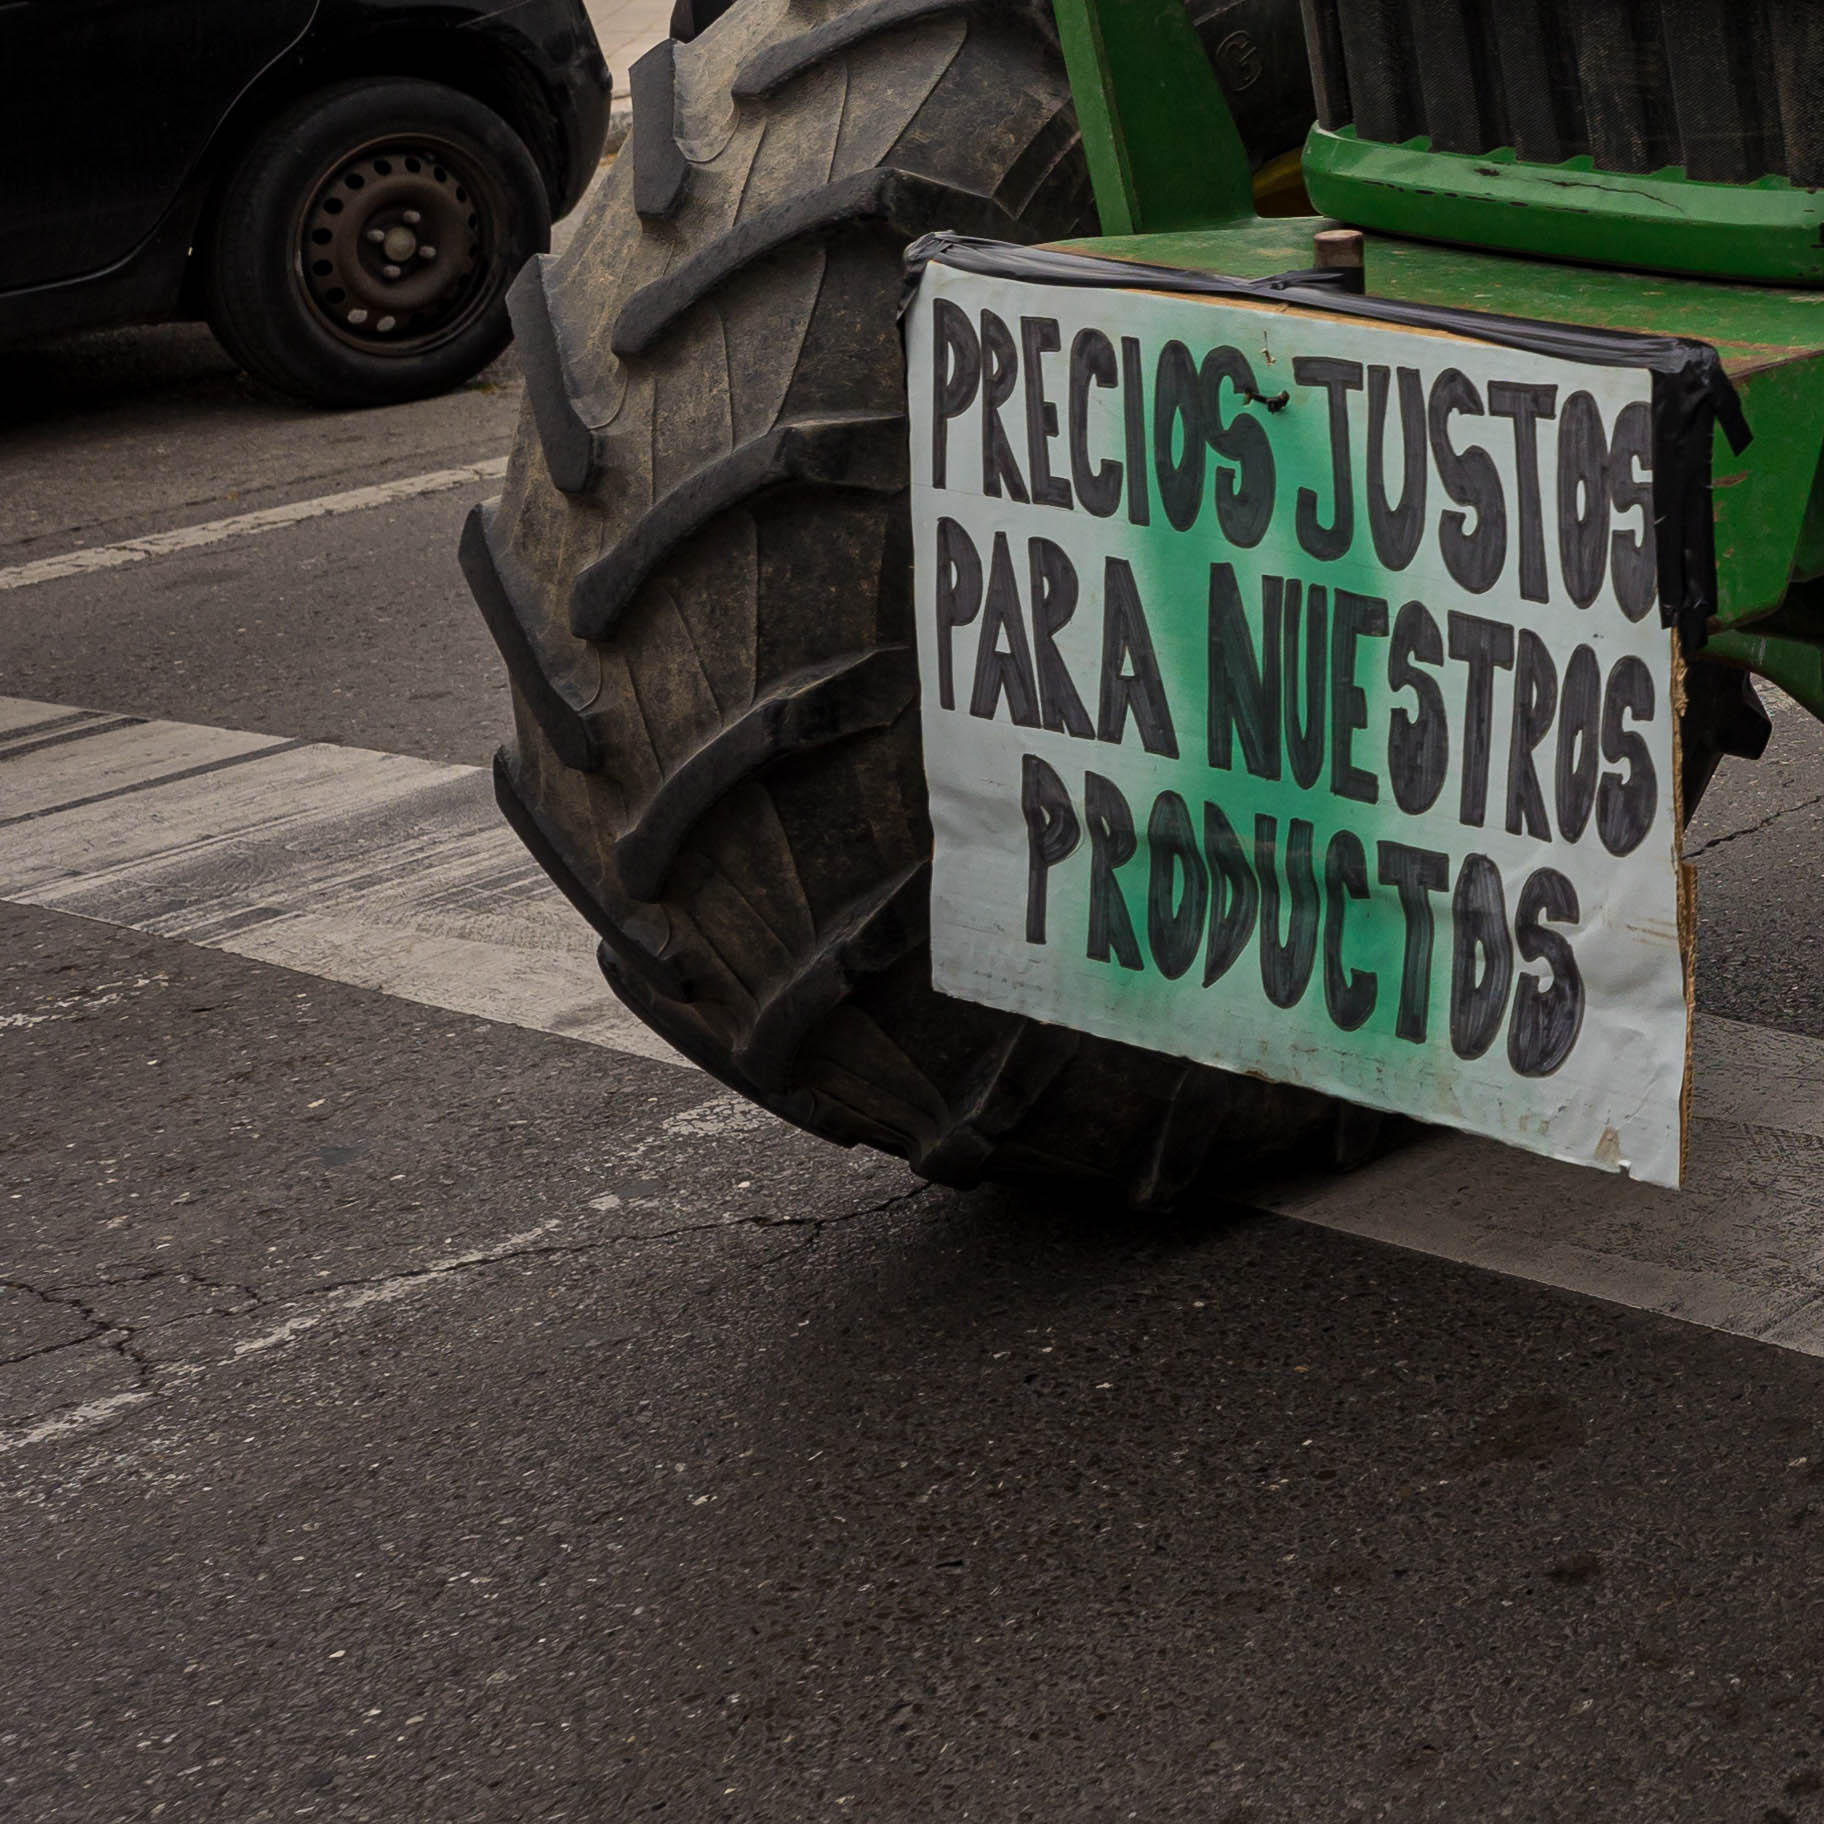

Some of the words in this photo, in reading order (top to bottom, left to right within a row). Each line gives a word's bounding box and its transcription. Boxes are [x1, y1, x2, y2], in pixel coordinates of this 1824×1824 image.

[929, 297, 1277, 549] PRECIOS
[1292, 354, 1658, 623] JUSTOS
[935, 515, 1181, 760] PARA
[1205, 561, 1658, 858] NUESTROS
[1021, 752, 1587, 1080] PRODUCTOS
